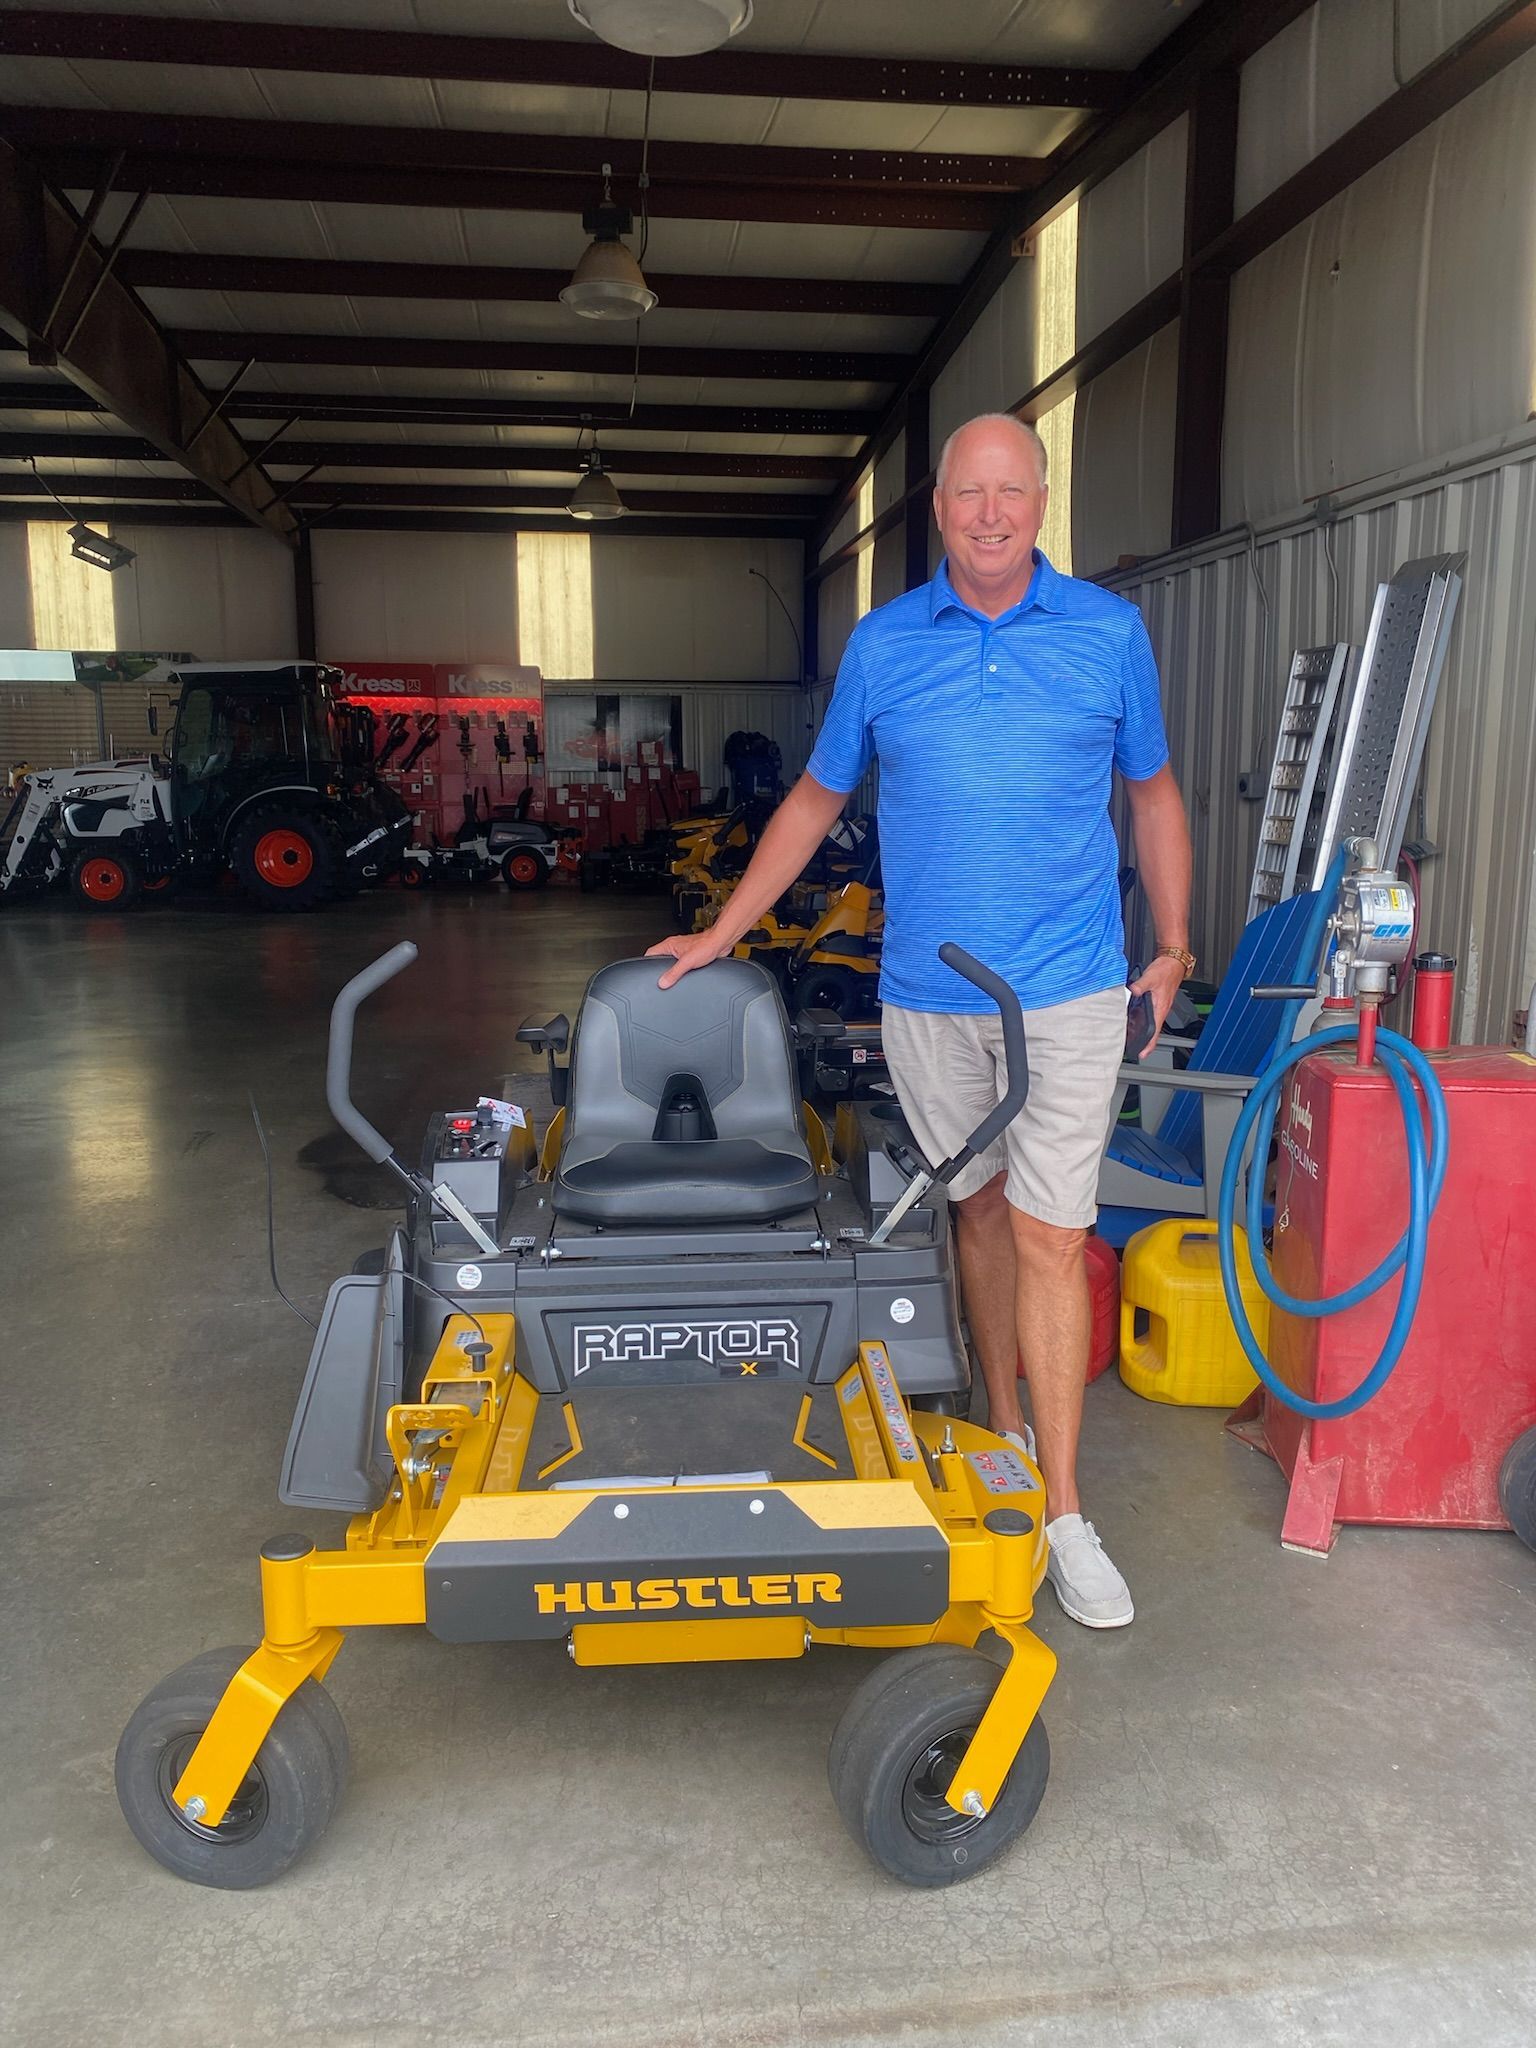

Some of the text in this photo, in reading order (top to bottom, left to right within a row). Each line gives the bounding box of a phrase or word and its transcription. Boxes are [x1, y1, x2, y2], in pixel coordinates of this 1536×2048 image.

[341, 672, 405, 693] Kress
[448, 674, 513, 694] Kress
[1372, 924, 1412, 938] GPI
[1281, 1130, 1319, 1180] GASOLINE
[573, 1318, 800, 1378] RAPTOR
[739, 1361, 759, 1376] X
[533, 1572, 843, 1615] HUSTLER
